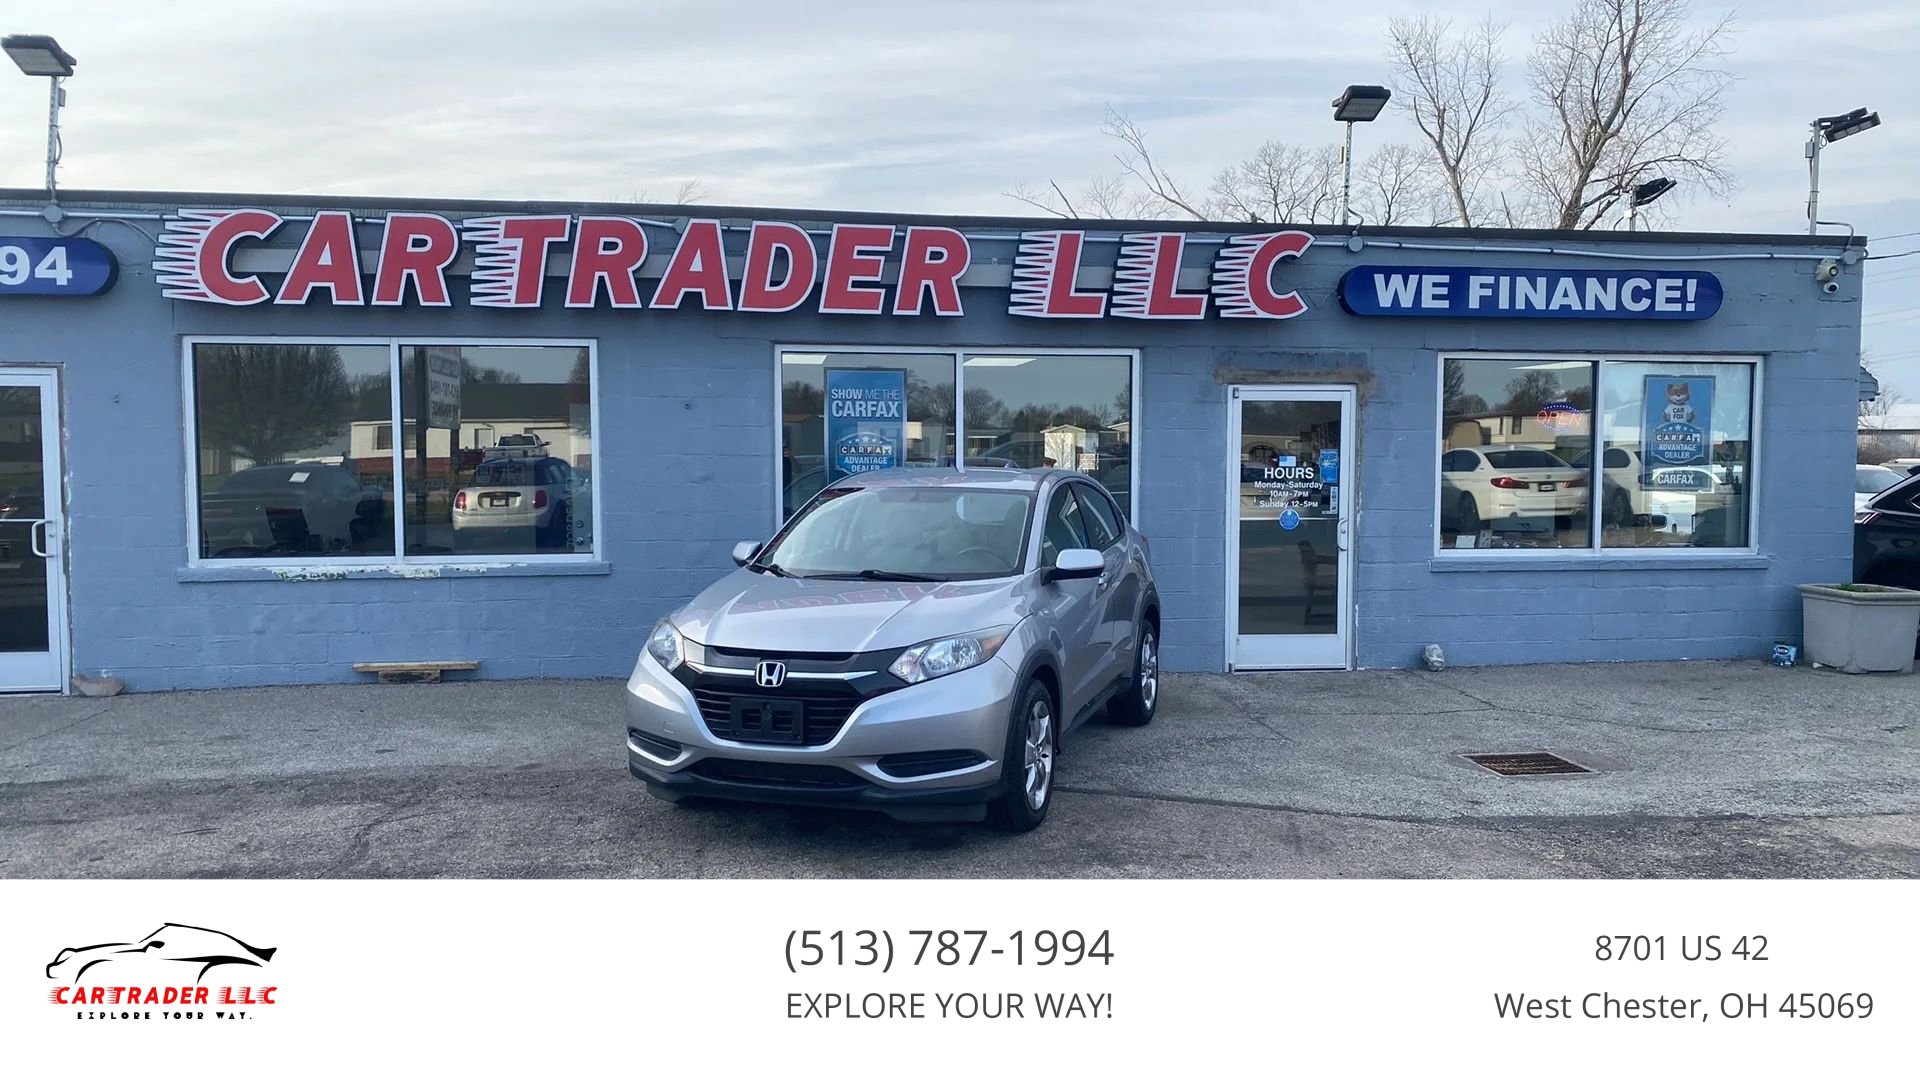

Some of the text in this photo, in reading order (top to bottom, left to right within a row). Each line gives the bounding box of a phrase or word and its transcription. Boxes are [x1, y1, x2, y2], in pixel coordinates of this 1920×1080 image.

[0, 245, 72, 286] 94
[1008, 230, 1316, 319] LLC
[1373, 273, 1698, 312] WE FINANCE!
[831, 388, 900, 400] SHOW ME THE
[831, 400, 901, 418] CARFAX
[1536, 410, 1583, 427] OPEN
[1656, 433, 1700, 442] CARFAX
[840, 445, 892, 455] CARFAX
[1664, 451, 1690, 459] DEALER
[844, 456, 888, 464] ADVANTAGE
[1264, 467, 1314, 479] HOURS
[1254, 480, 1324, 489] Monday-Saturday
[1657, 474, 1695, 485] CARFAX
[1259, 500, 1289, 509] Sunday
